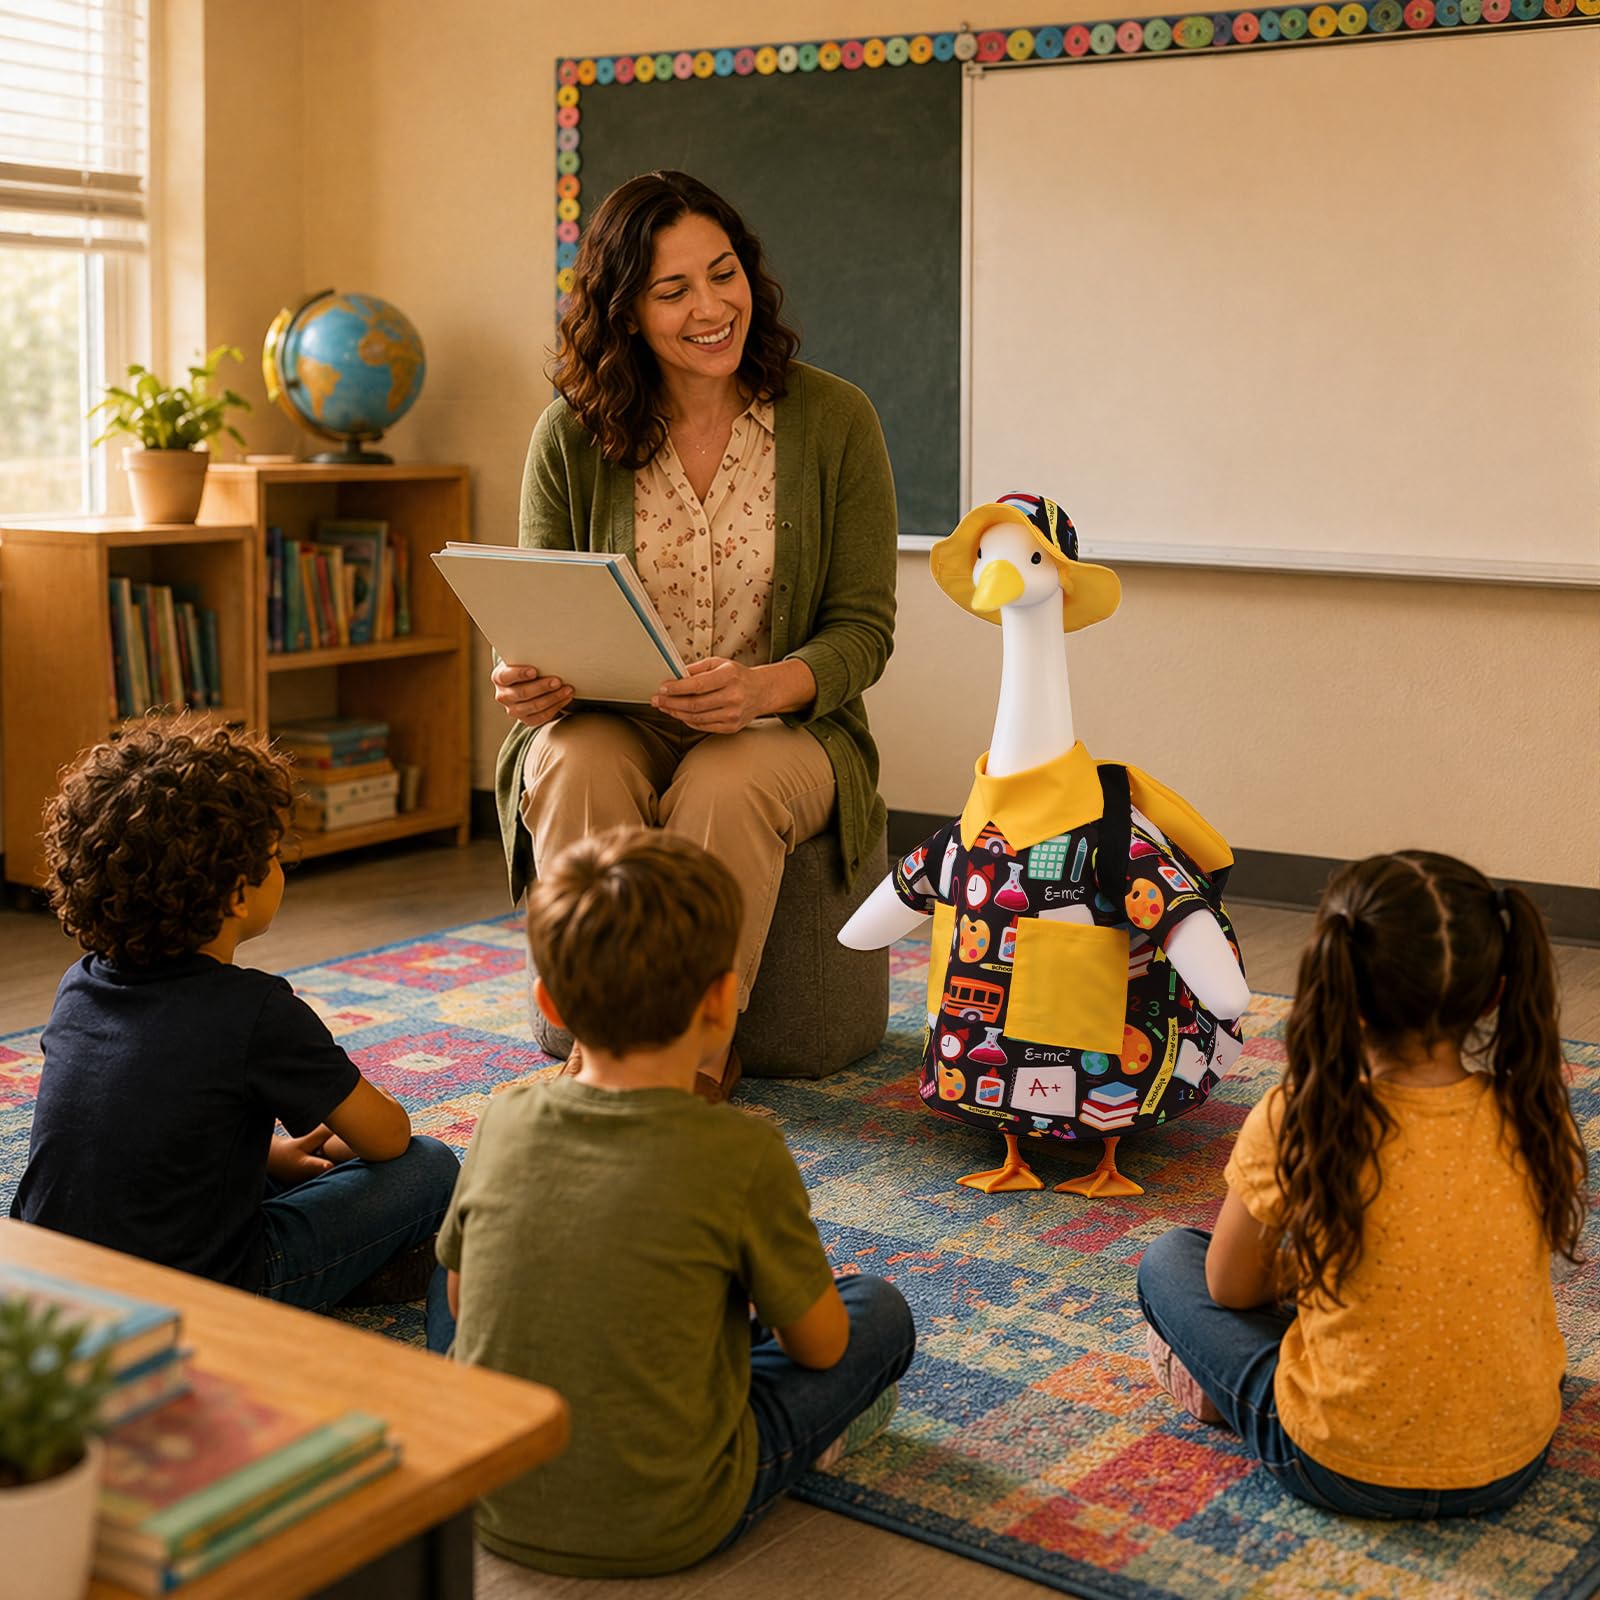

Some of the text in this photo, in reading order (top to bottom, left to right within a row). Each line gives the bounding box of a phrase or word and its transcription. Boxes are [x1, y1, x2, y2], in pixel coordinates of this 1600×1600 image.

[1148, 1000, 1160, 1017] 3
[1028, 1078, 1062, 1097] A+
[1188, 1088, 1195, 1100] 2
